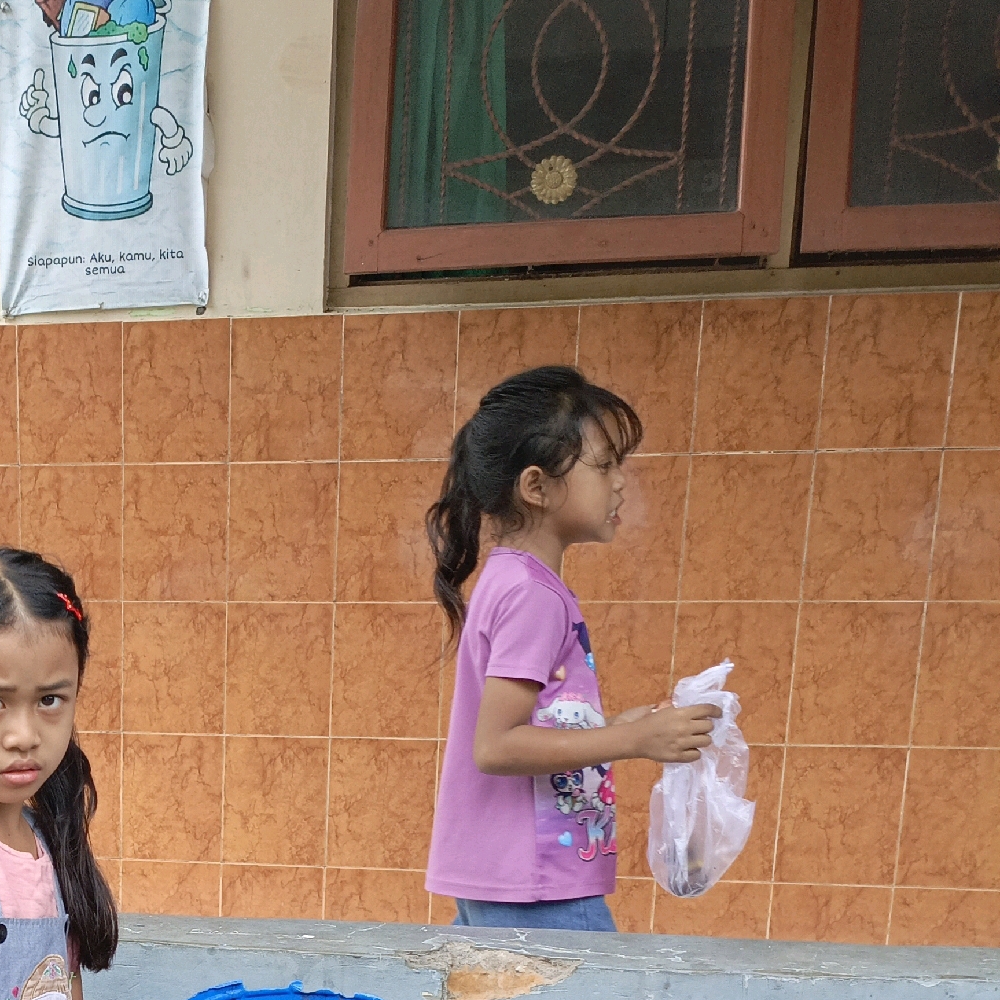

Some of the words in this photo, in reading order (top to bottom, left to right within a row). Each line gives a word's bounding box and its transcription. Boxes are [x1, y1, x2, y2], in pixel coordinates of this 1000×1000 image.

[89, 252, 115, 263] Aku,
[119, 251, 155, 261] kamu,
[159, 248, 184, 260] kita
[85, 265, 126, 275] semua
